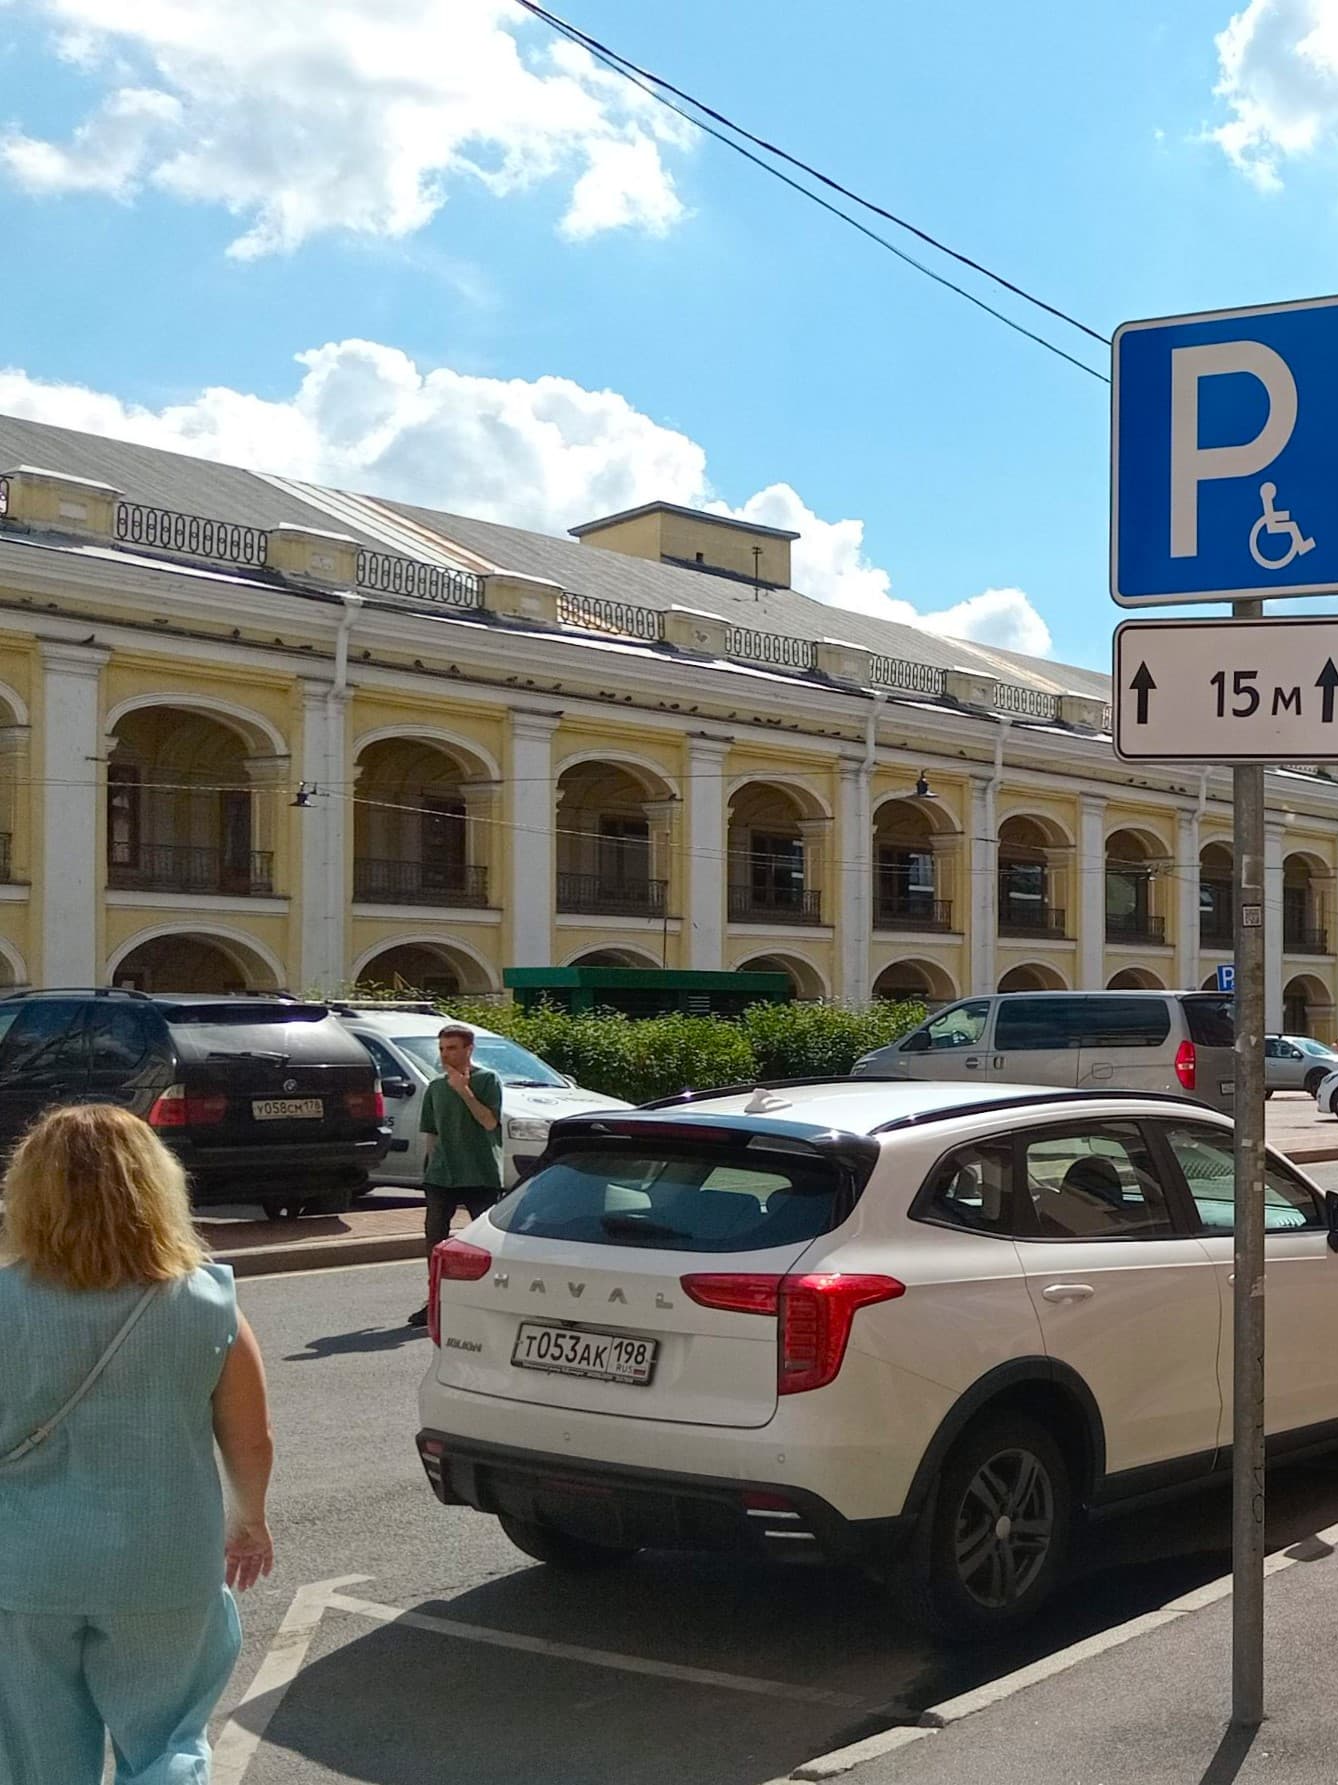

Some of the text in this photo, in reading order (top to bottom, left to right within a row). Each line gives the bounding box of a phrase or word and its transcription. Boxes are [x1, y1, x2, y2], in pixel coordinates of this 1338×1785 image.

[1170, 340, 1298, 558] P
[1210, 670, 1260, 718] 15
[493, 1273, 674, 1310] HAVAL
[613, 1341, 647, 1365] 198
